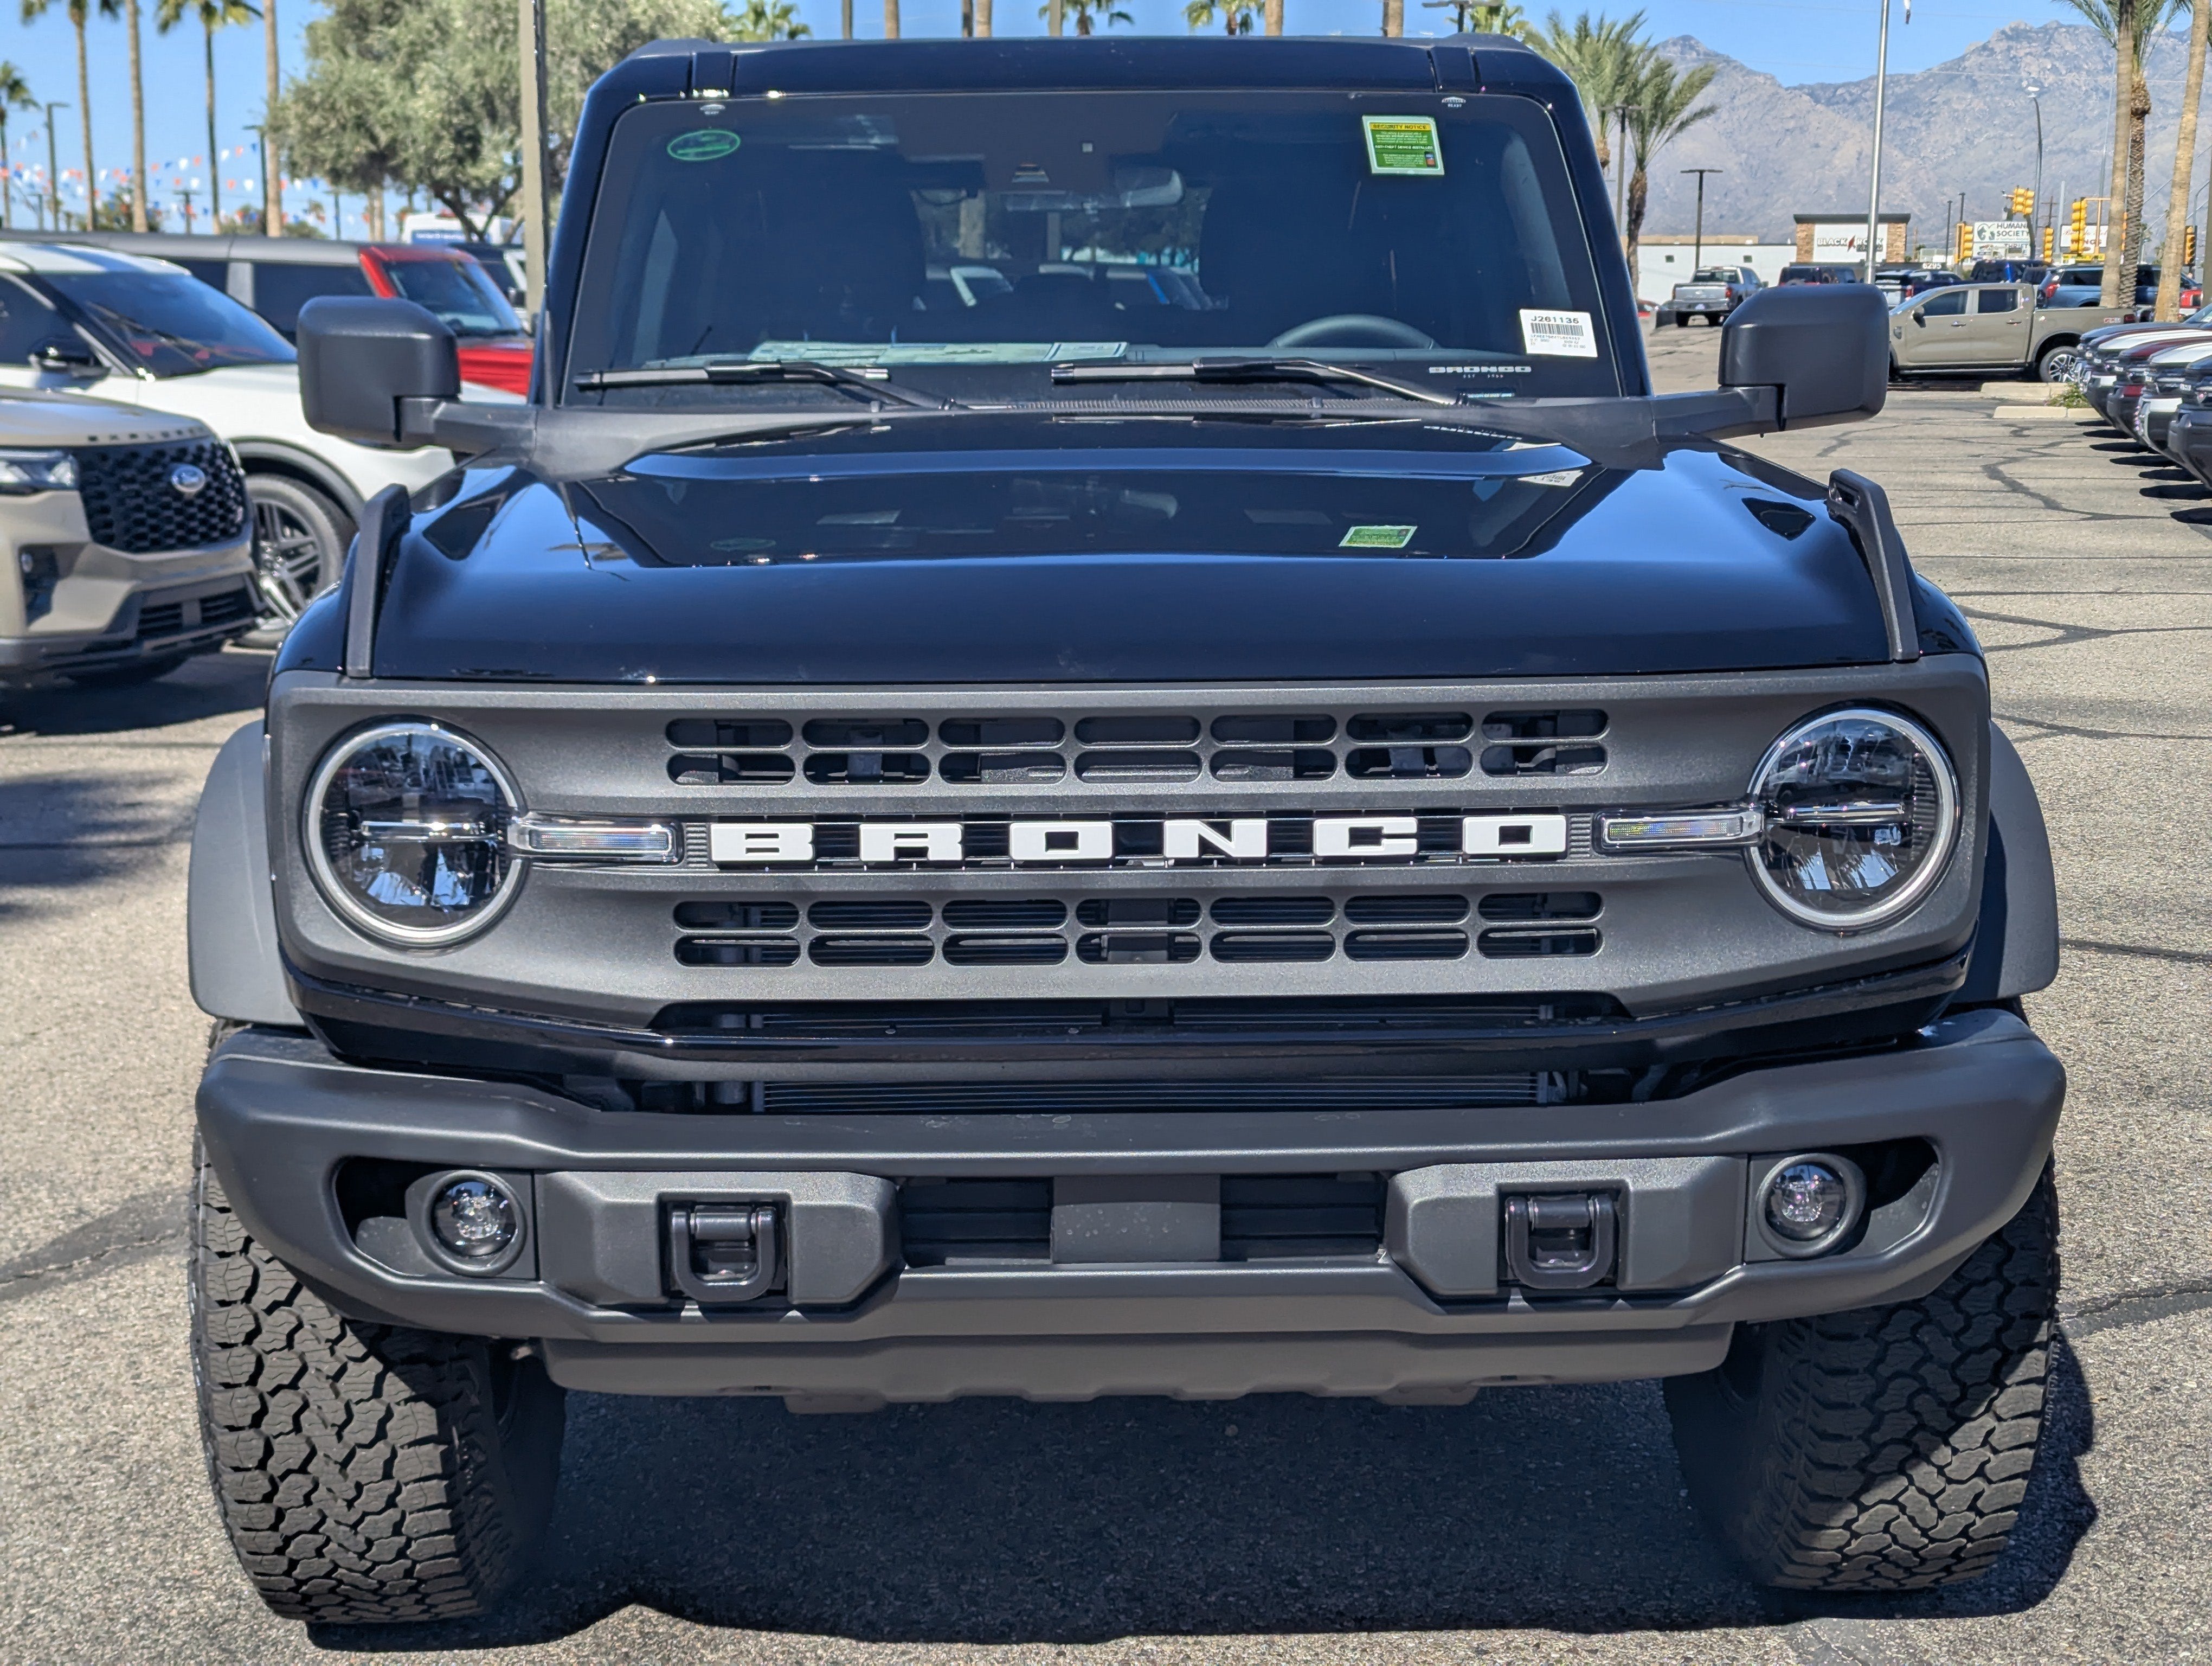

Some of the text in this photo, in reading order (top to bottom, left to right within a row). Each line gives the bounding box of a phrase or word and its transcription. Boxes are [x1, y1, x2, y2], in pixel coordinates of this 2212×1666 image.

[1817, 238, 1884, 246] BLACK ROK
[711, 815, 1566, 861] BRONCO
